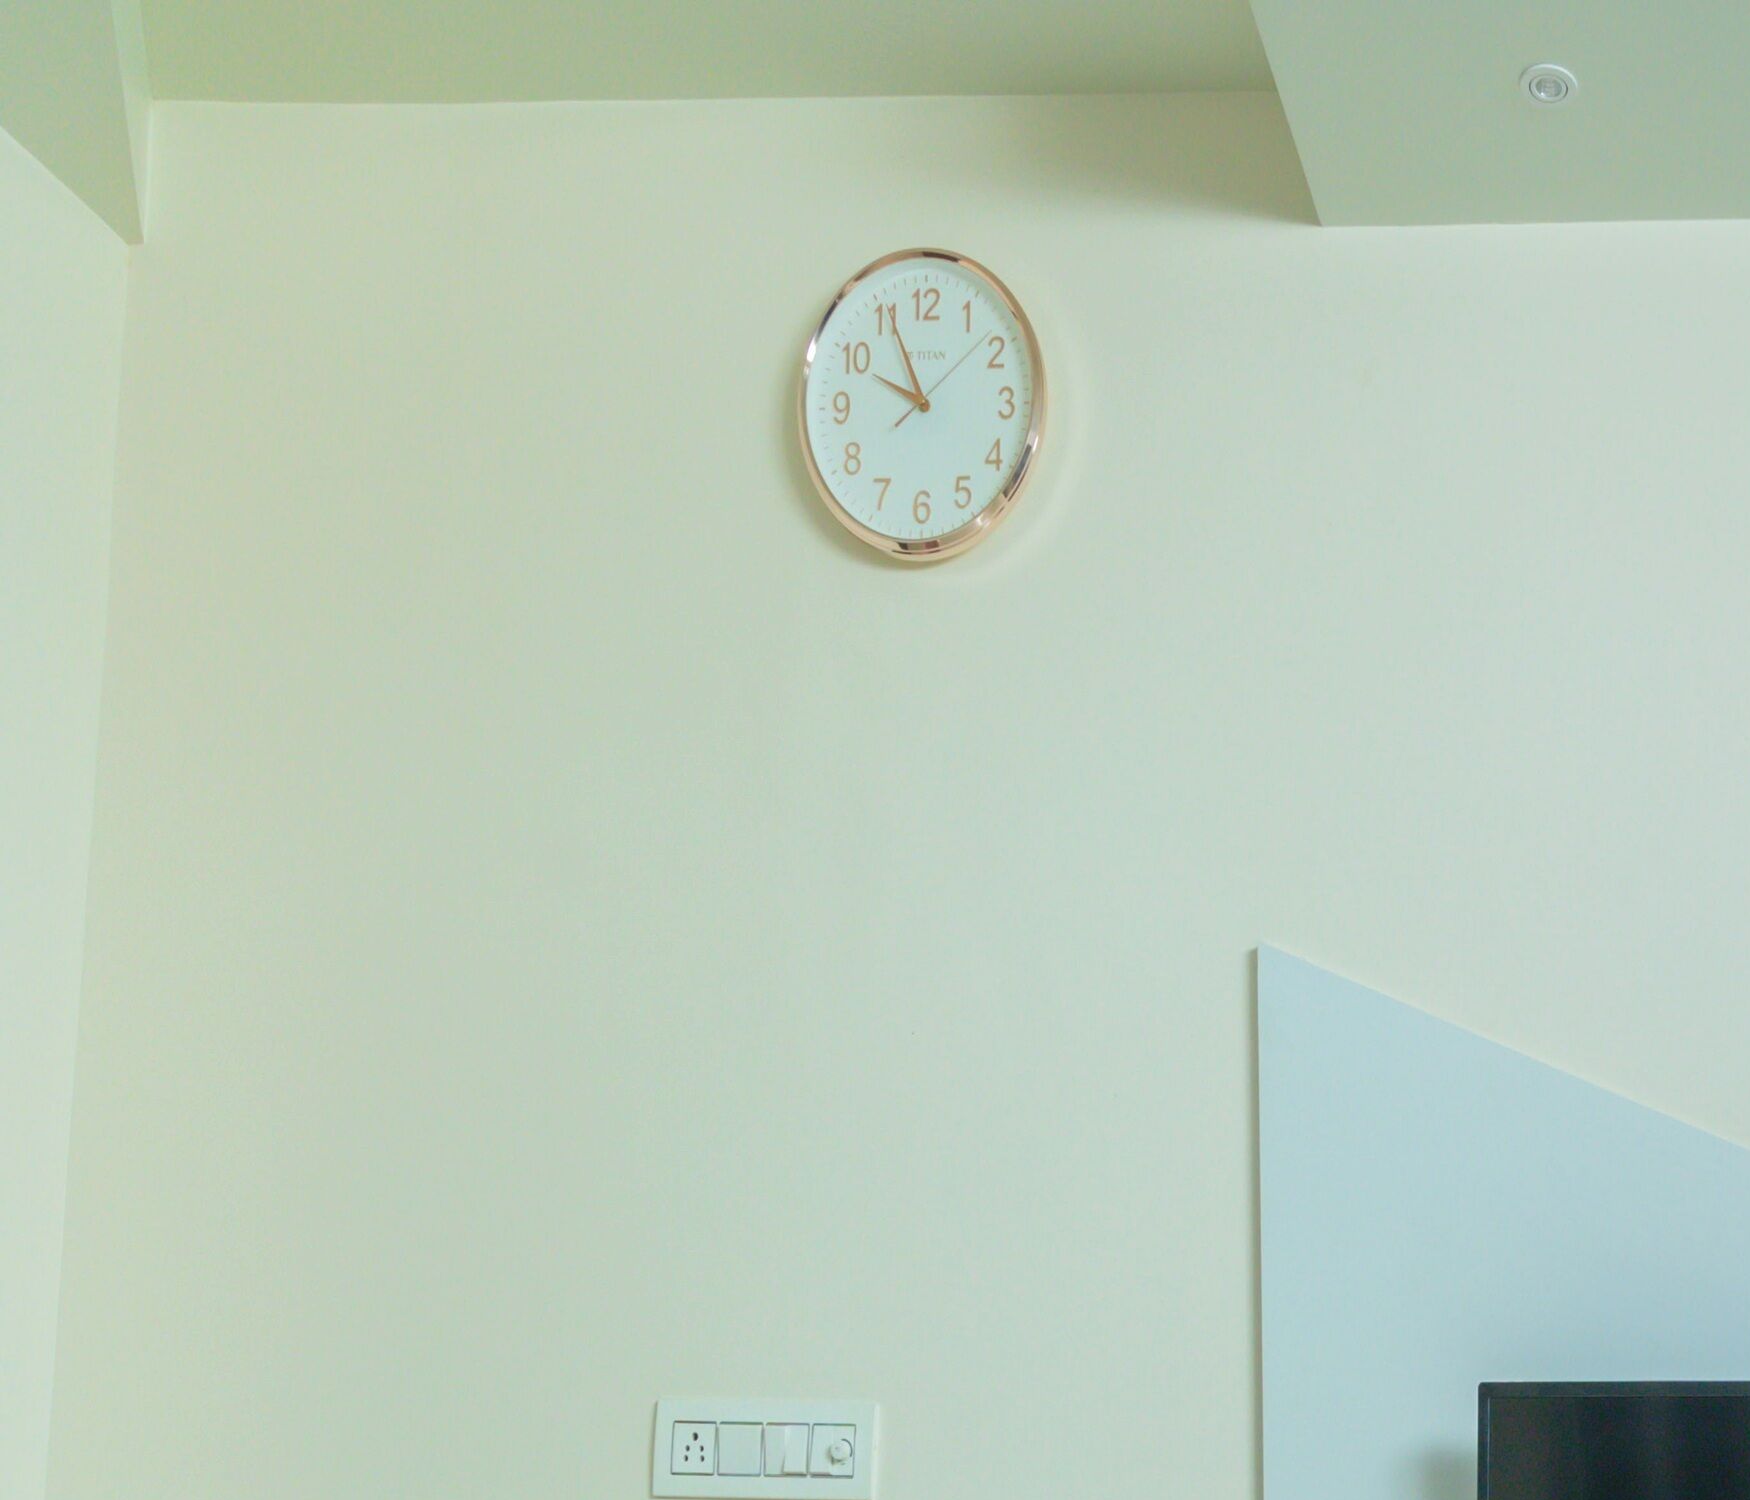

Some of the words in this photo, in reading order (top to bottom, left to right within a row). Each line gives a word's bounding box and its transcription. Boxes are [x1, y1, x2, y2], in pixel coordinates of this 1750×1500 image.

[874, 303, 897, 336] 11
[912, 288, 940, 320] 12
[962, 300, 972, 333] 1
[842, 342, 870, 374] 10
[917, 350, 946, 361] TITAN
[987, 336, 1005, 369] 2
[832, 391, 850, 425] 9
[998, 386, 1015, 420] 3
[844, 442, 862, 475] 8
[985, 438, 1003, 472] 4
[873, 478, 892, 511] 7
[913, 490, 931, 523] 6
[954, 475, 972, 509] 5
